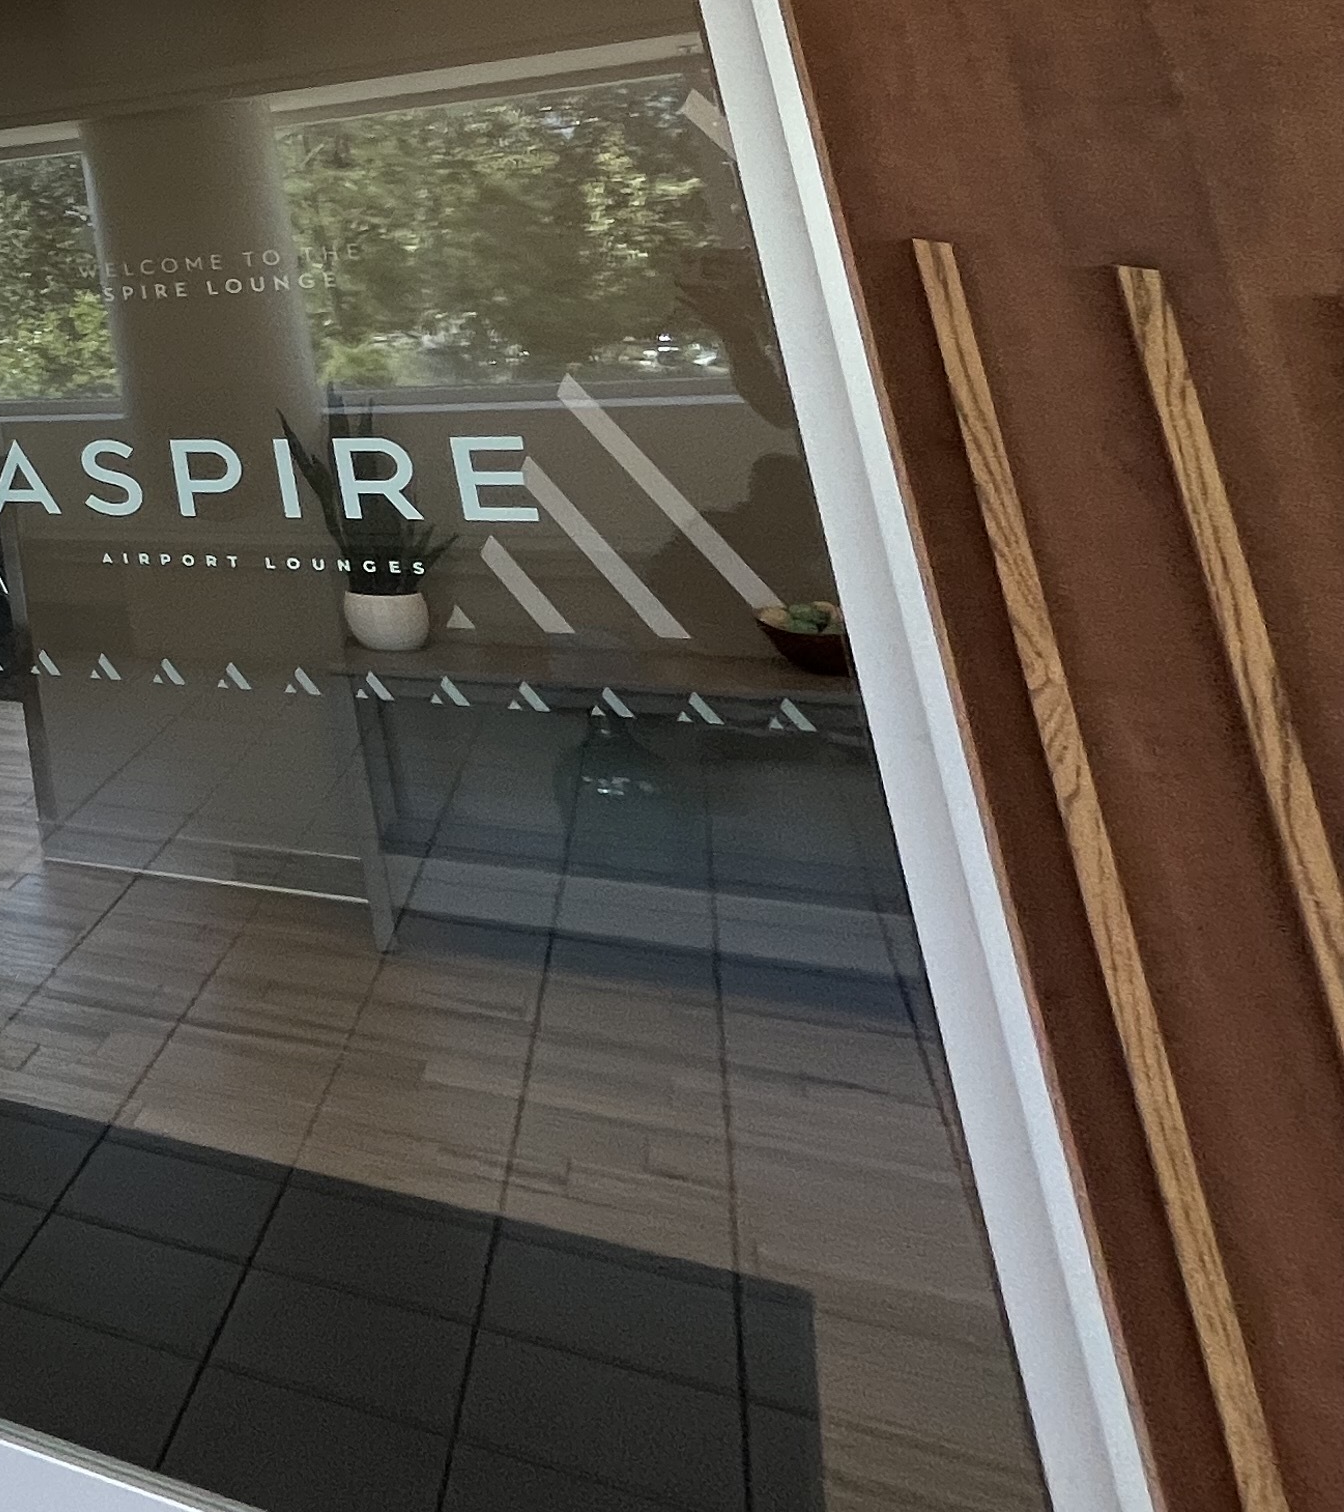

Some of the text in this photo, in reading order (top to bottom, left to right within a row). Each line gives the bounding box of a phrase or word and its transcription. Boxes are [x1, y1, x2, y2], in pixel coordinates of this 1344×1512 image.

[77, 253, 223, 278] WELCOME
[242, 248, 281, 267] TO
[206, 271, 338, 296] LOUNGE
[101, 551, 426, 576] AIRPORT LOUNGES
